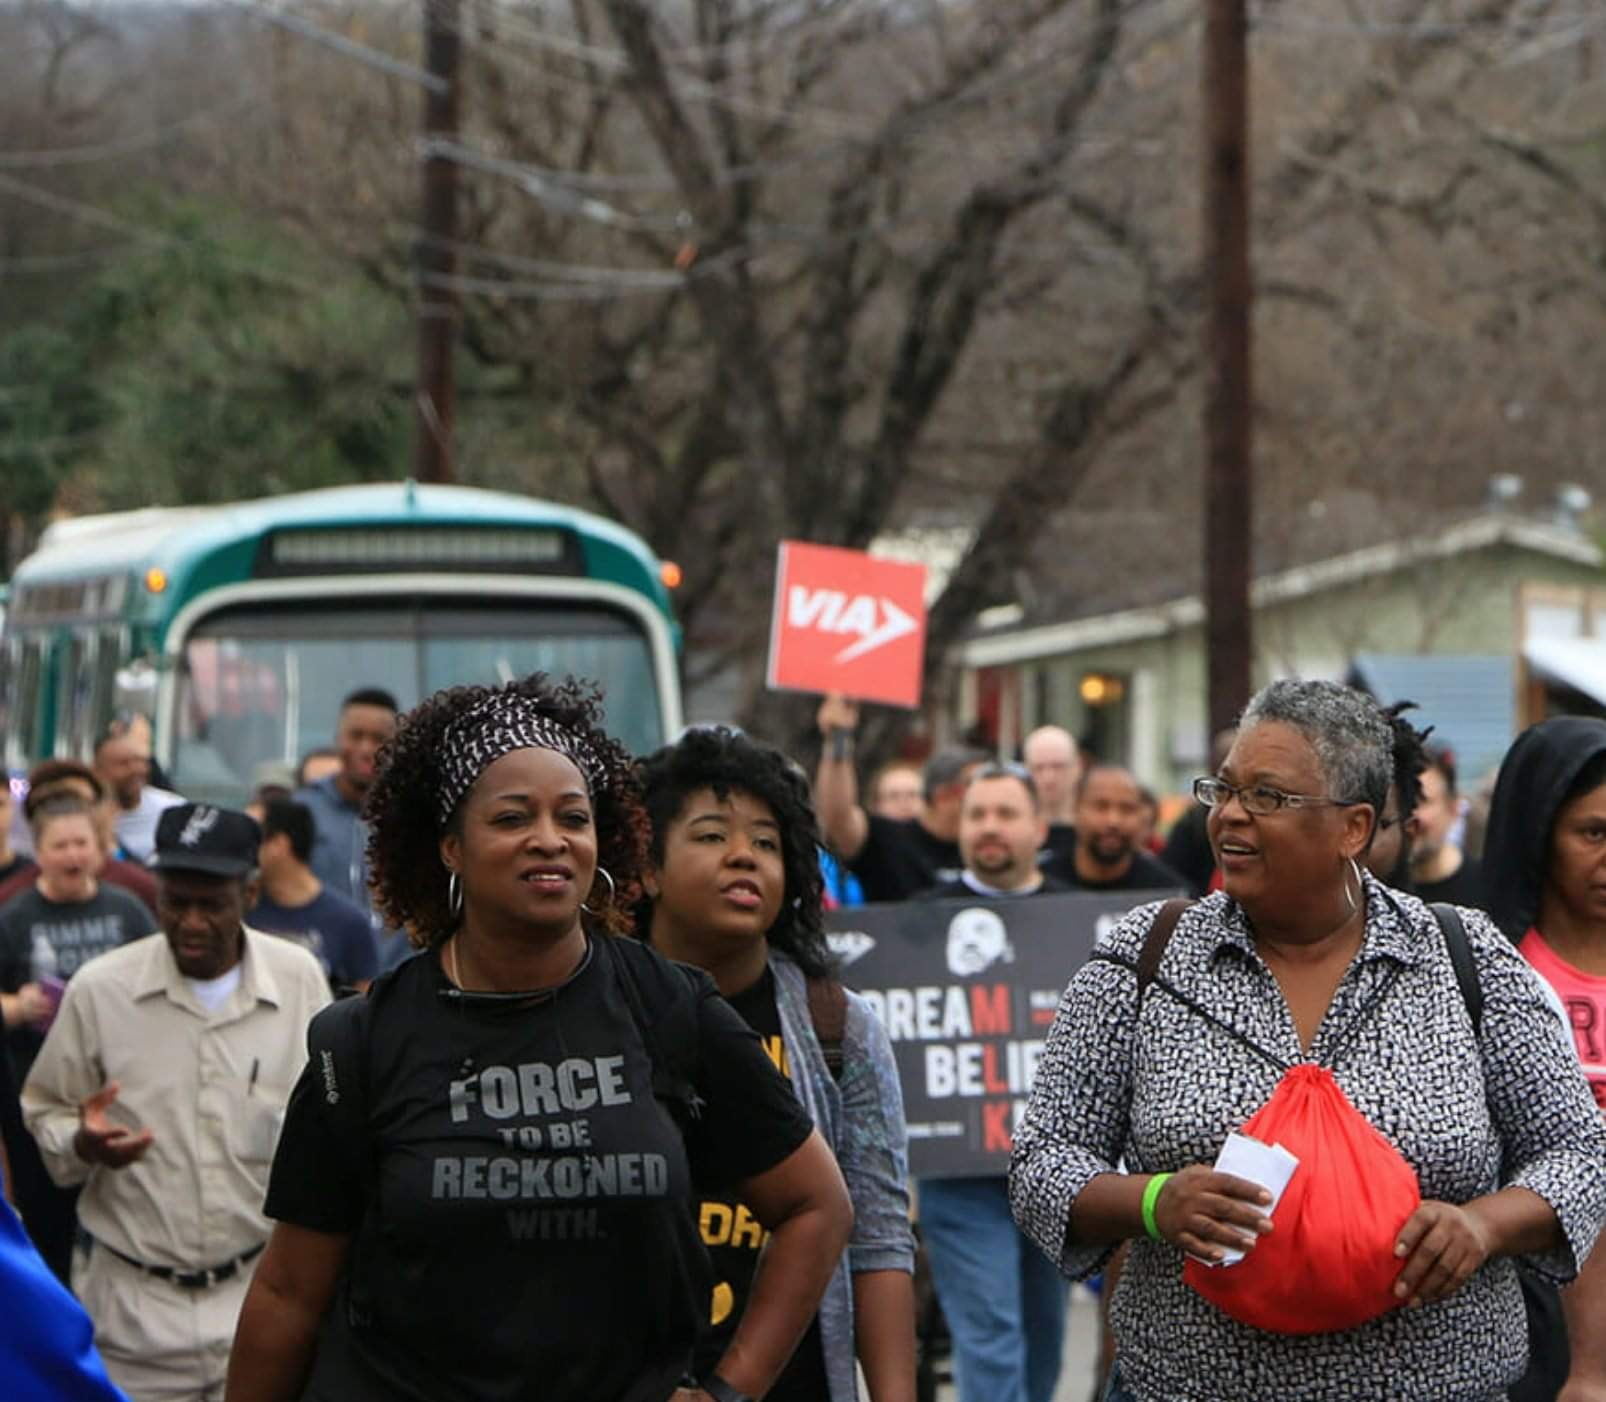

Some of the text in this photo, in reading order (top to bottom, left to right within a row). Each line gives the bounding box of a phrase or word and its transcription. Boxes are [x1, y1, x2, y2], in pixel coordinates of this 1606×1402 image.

[789, 585, 875, 635] VIA
[449, 1055, 632, 1122] FORCE
[498, 1119, 592, 1150] TO BE
[432, 1153, 668, 1198] RECKONED
[505, 1207, 608, 1241] WITH.
